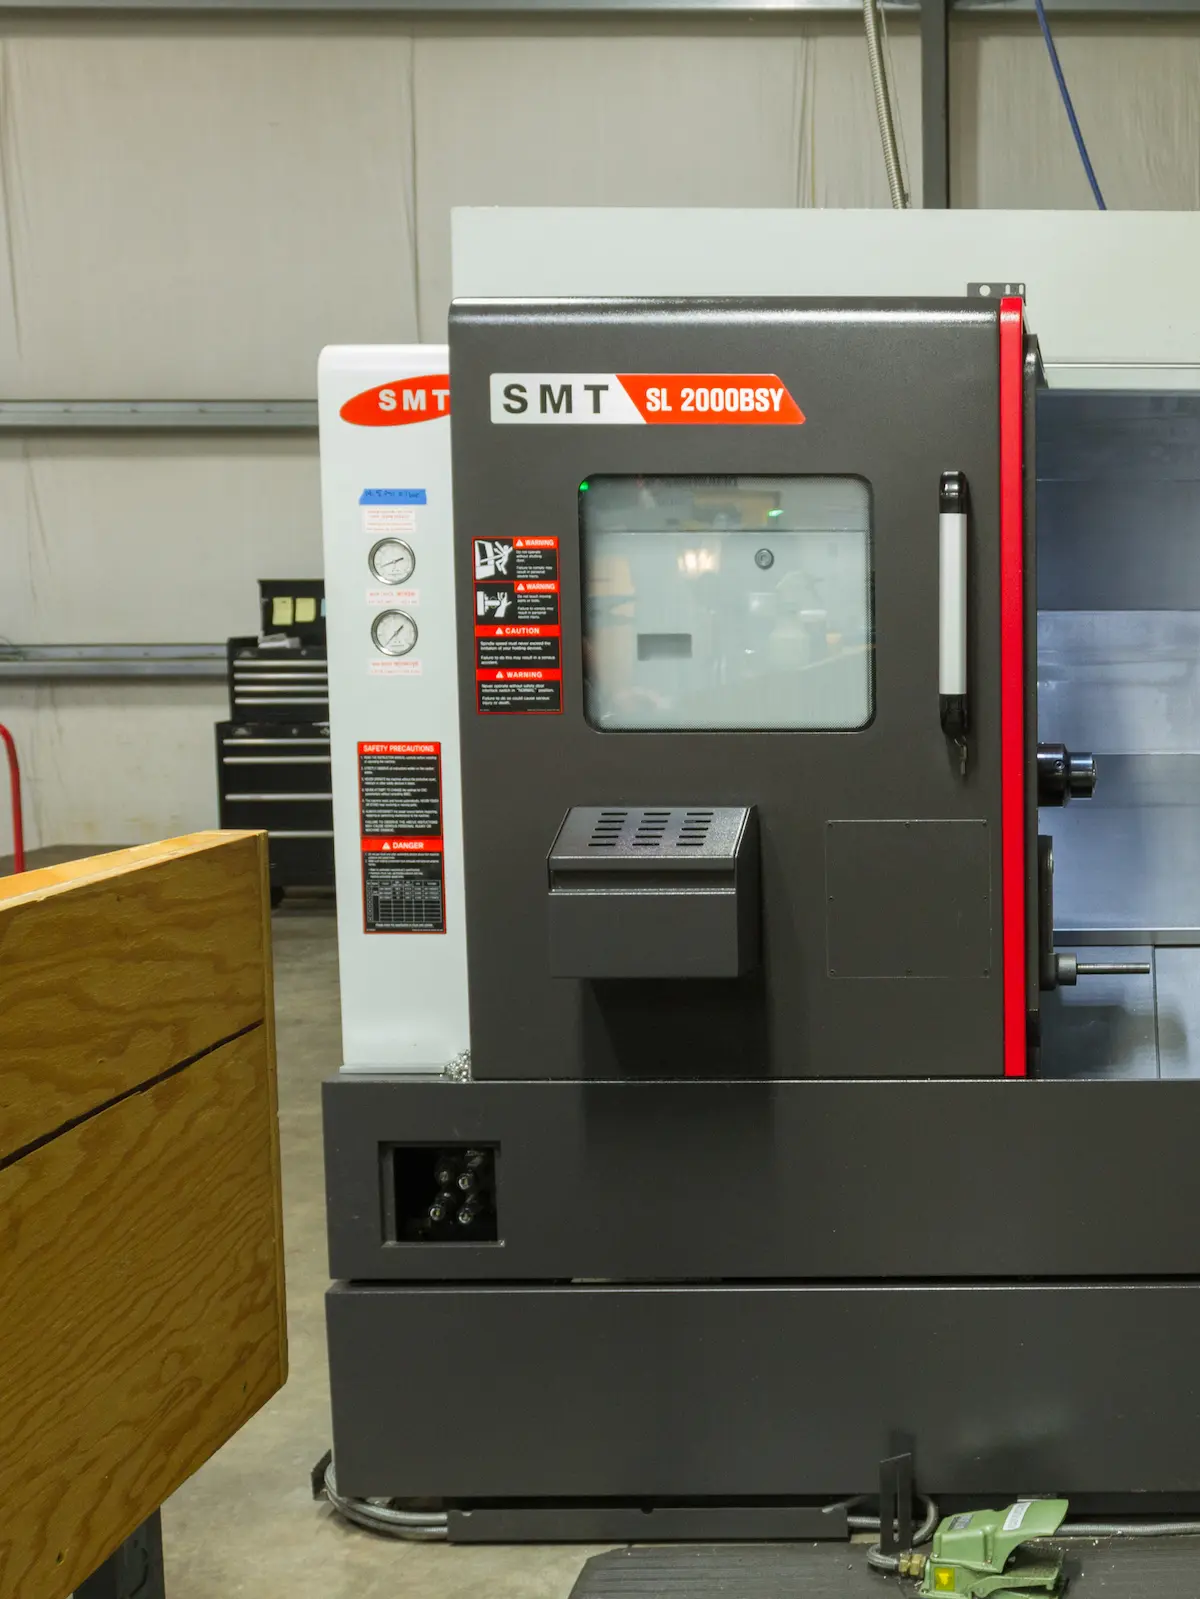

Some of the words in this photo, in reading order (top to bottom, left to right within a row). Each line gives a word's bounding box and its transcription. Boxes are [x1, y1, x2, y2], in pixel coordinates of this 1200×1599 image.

[378, 388, 450, 411] SMT
[502, 383, 610, 414] SMT
[645, 388, 672, 412] SL
[680, 387, 784, 412] 2000BSY
